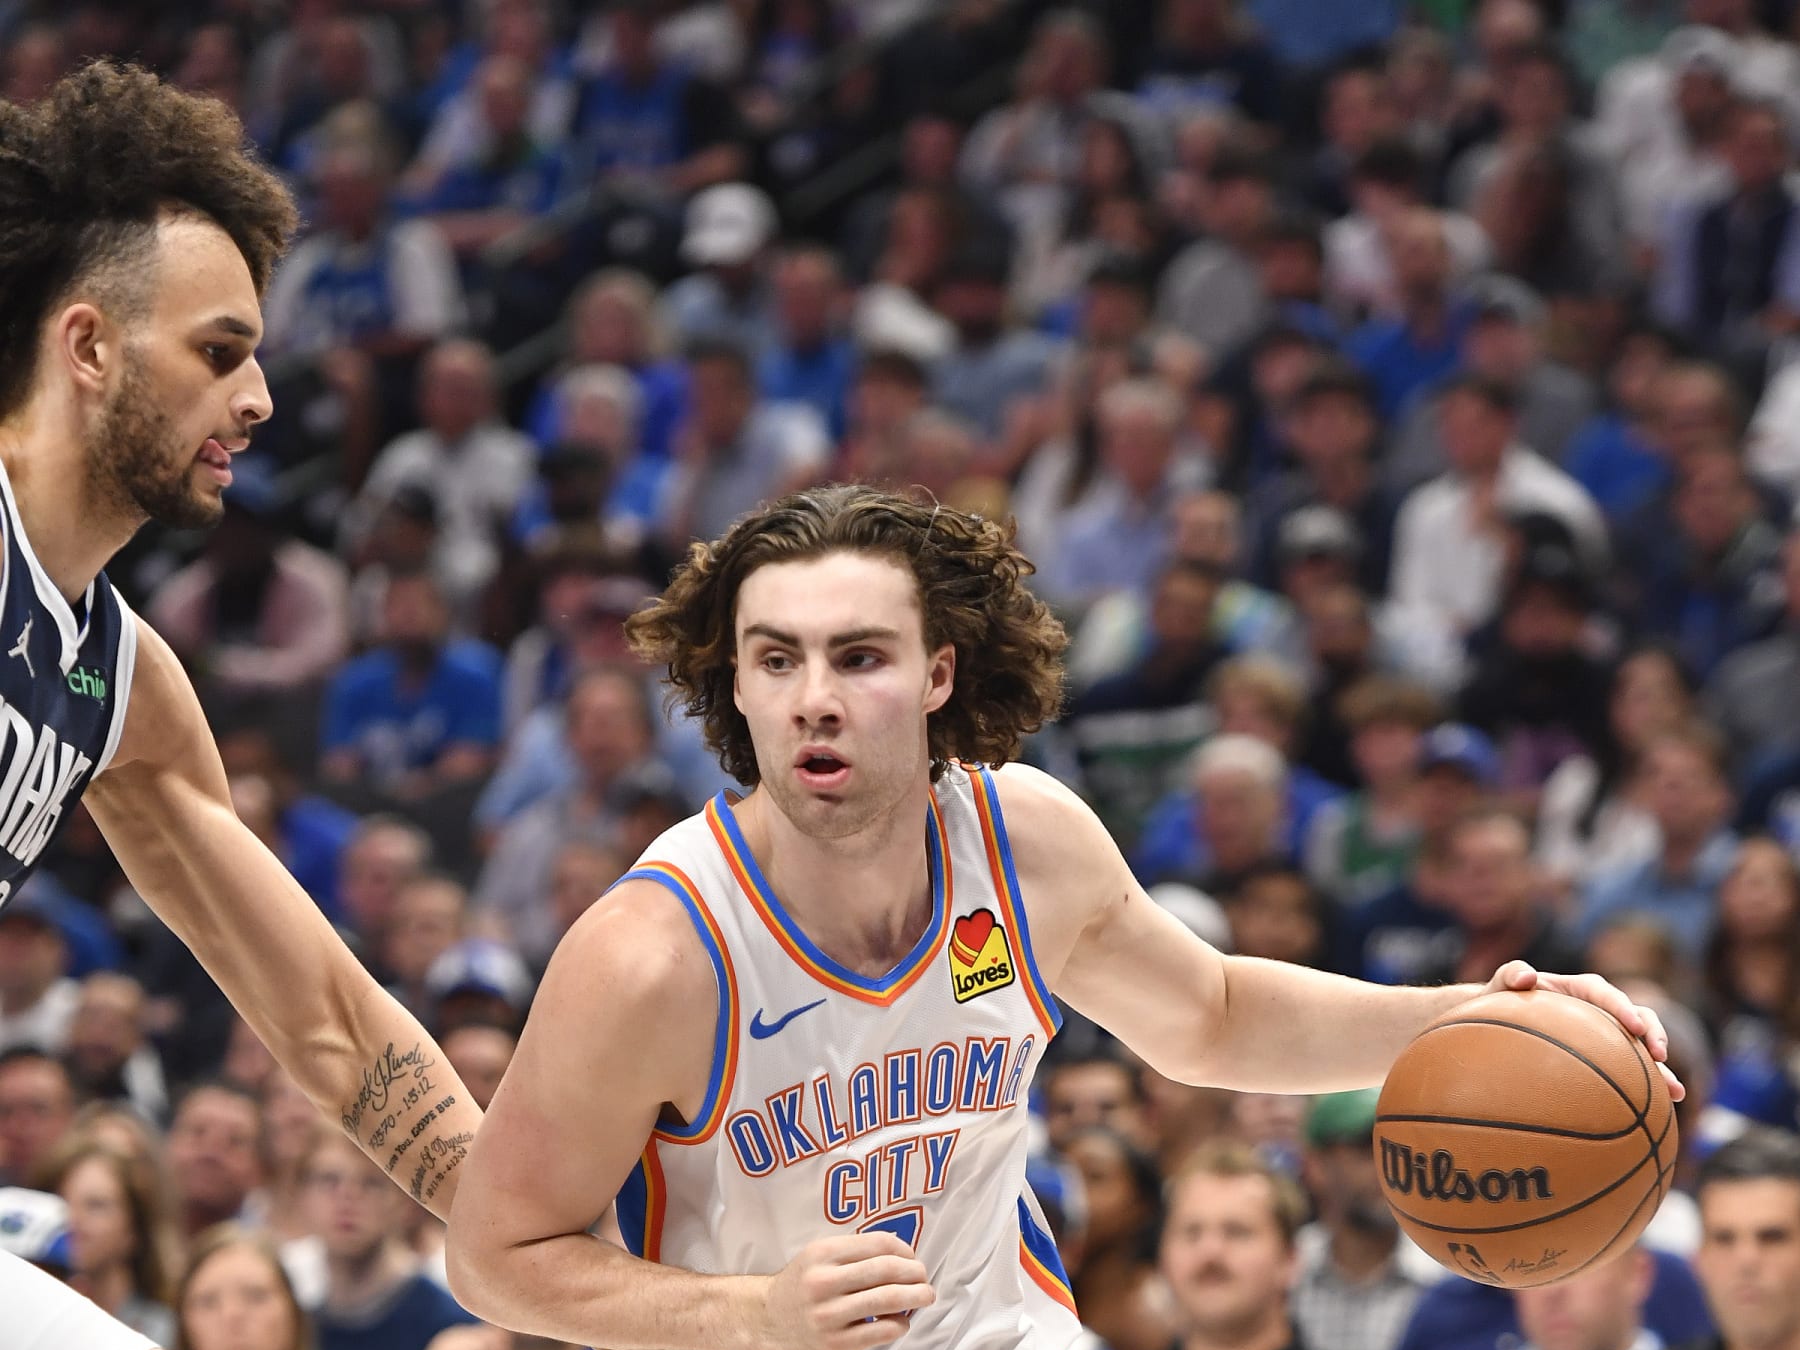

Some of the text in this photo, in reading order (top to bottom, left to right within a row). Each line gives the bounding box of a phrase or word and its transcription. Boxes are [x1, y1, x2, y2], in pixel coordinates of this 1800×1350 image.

[724, 1034, 1035, 1178] OKLAHOMA
[823, 1128, 961, 1225] CITY
[1380, 1136, 1554, 1203] Wilson
